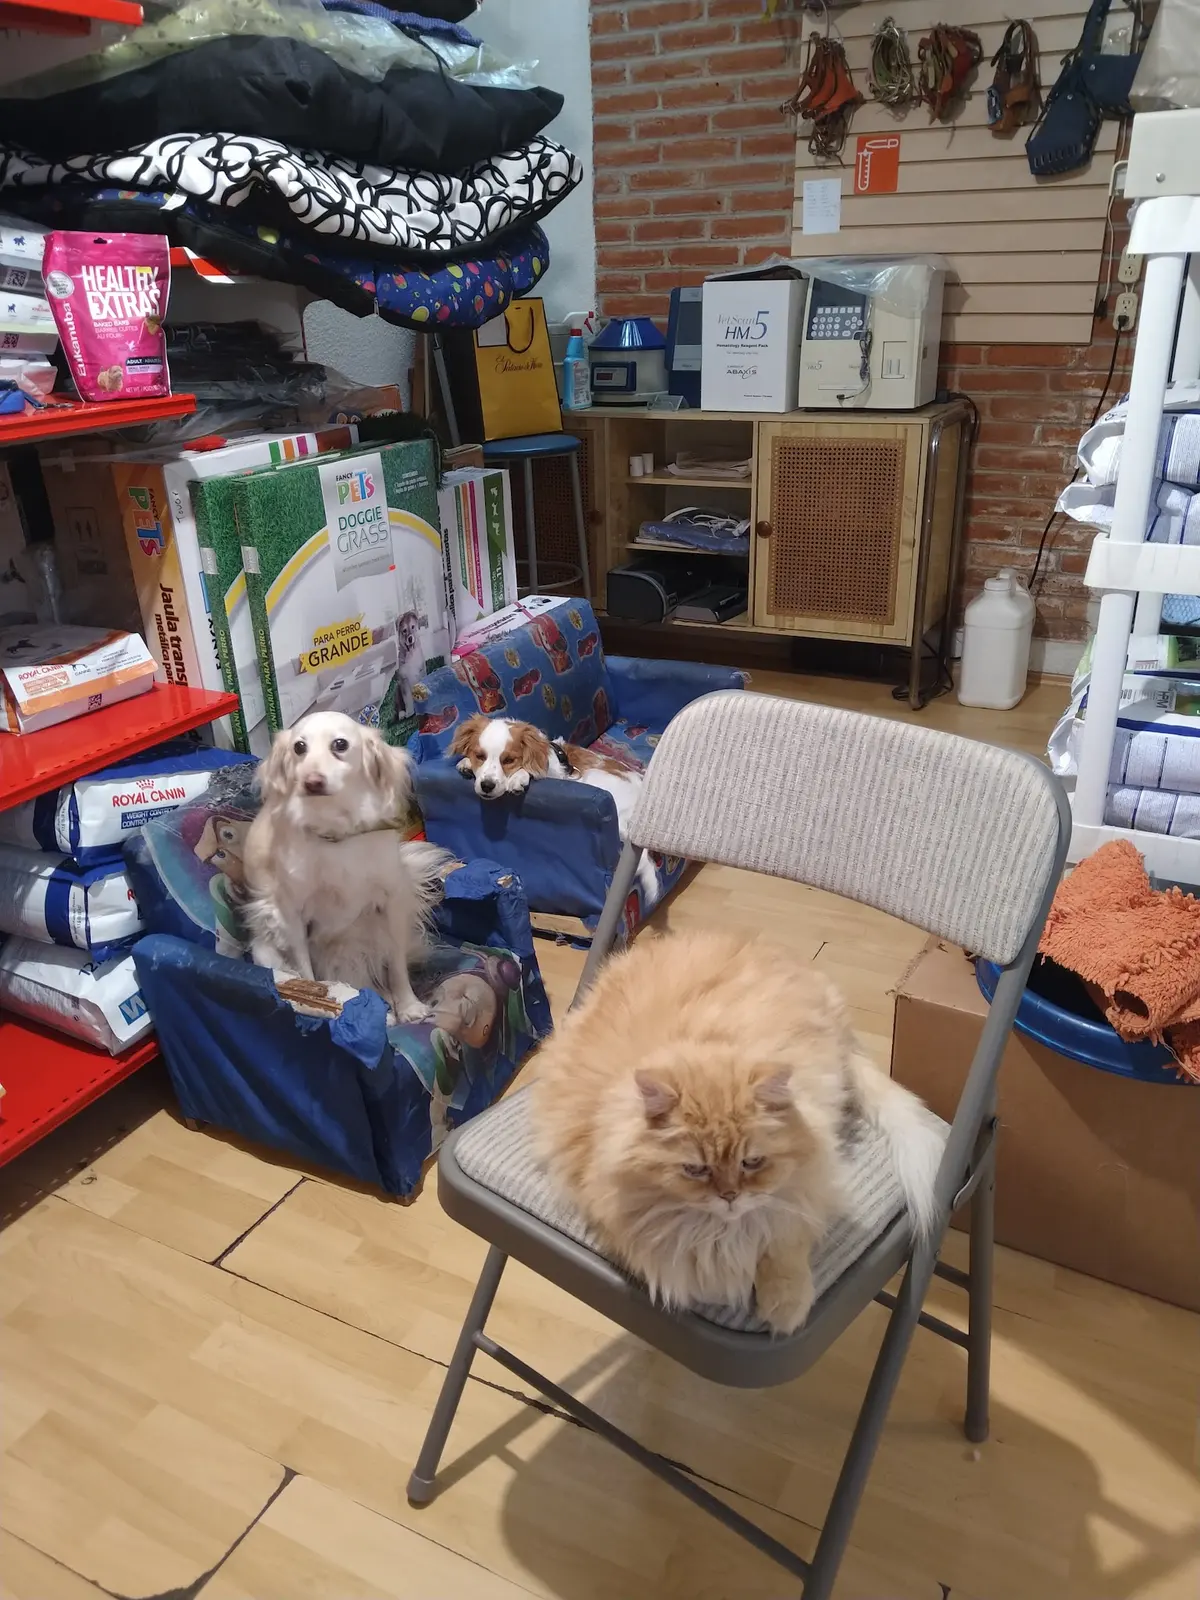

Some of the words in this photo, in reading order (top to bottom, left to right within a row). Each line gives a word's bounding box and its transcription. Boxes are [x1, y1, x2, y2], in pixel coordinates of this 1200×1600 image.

[82, 265, 159, 292] HEALTHY
[86, 289, 160, 320] EXTRAS
[63, 302, 87, 377] Eukanuba
[336, 471, 354, 482] FANCY
[337, 469, 376, 506] PETS
[127, 487, 166, 557] PETS
[338, 506, 383, 531] DOGGIE
[337, 521, 389, 553] GRASS
[160, 583, 180, 632] Jaula
[155, 613, 171, 661] metálica
[258, 628, 269, 658] PERRO
[313, 632, 335, 646] PARA
[335, 621, 361, 638] PERRO
[308, 631, 369, 667] GRANDE
[263, 661, 273, 685] PARA
[112, 792, 149, 807] ROYAL
[150, 786, 186, 802] CANIN
[126, 811, 149, 820] WEIGHT
